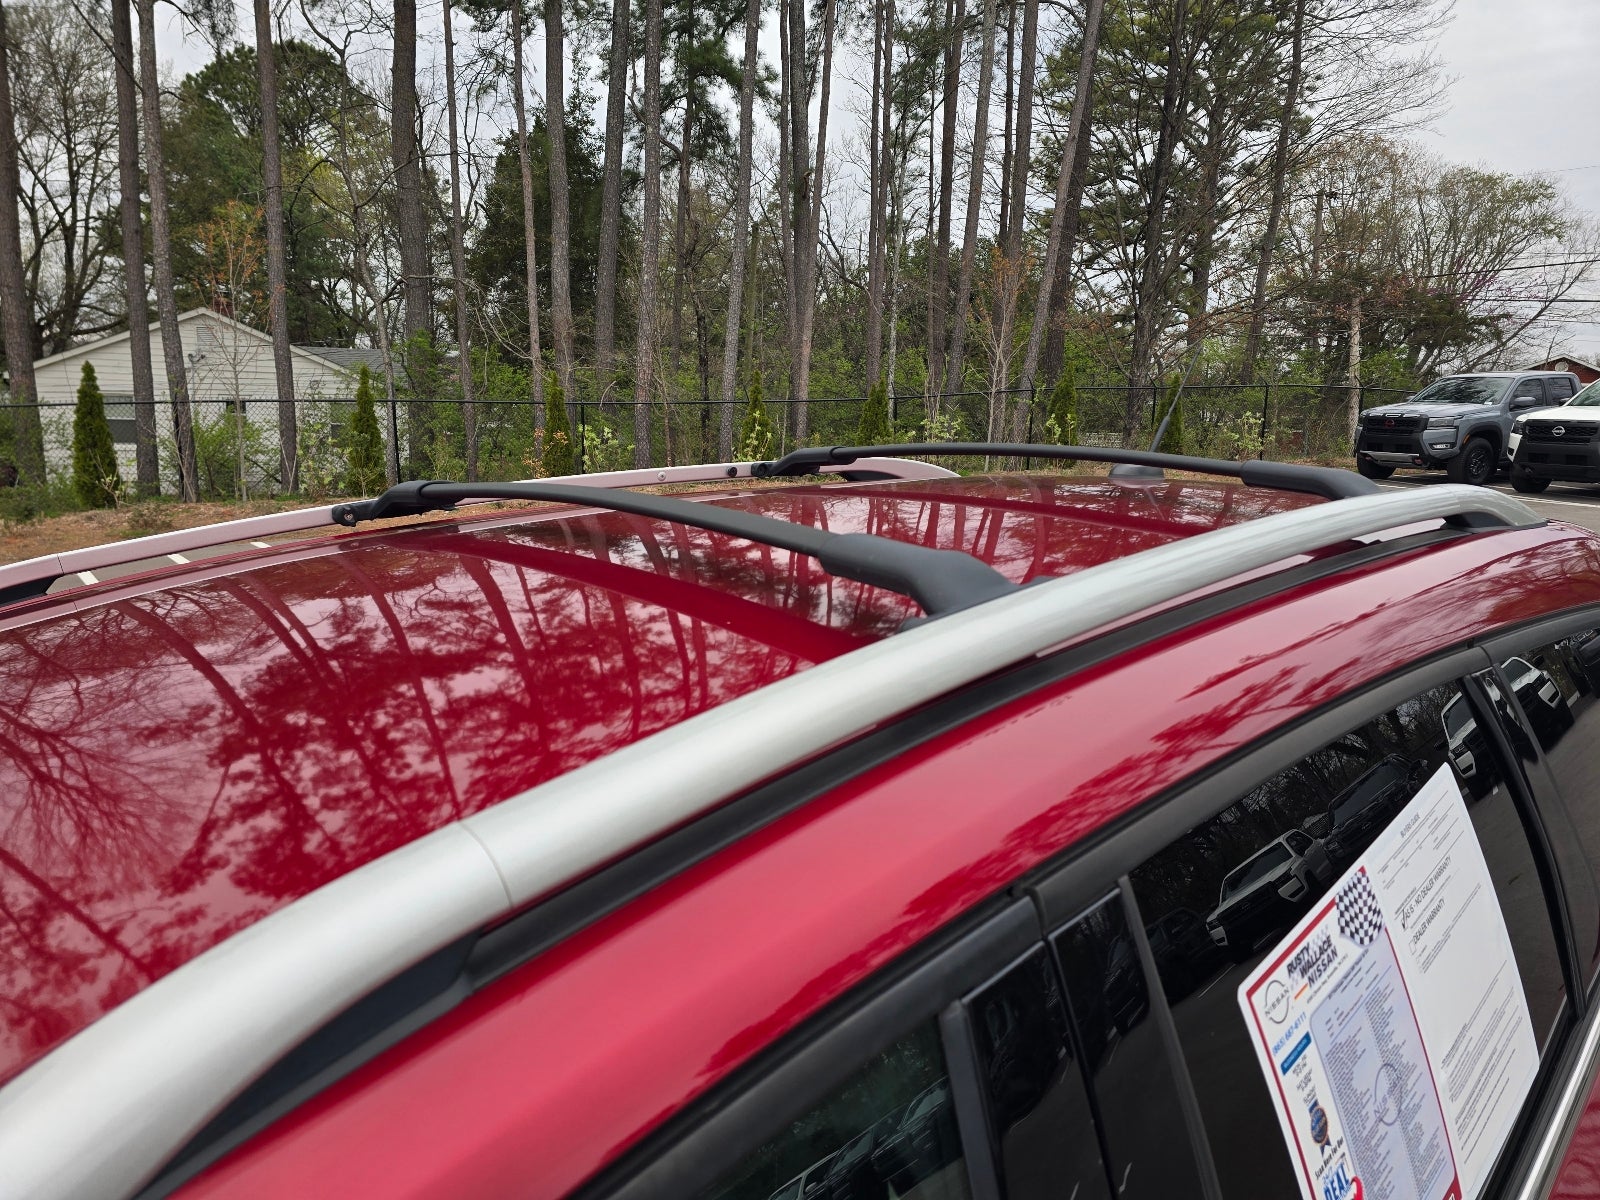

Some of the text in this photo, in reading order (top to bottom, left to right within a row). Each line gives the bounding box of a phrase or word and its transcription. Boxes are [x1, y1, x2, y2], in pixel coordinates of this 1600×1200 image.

[1420, 877, 1435, 900] DEALER
[1433, 855, 1452, 883] WARRANTY
[1412, 921, 1428, 944] DEALER
[1425, 897, 1445, 927] WARRANTY
[1287, 942, 1310, 978] RUSTY
[1299, 935, 1332, 979] WALLACE
[1307, 946, 1338, 988] NISSAN
[1264, 986, 1289, 1017] NISSAN
[1314, 1165, 1325, 1180] Scan
[1323, 1153, 1333, 1168] Here
[1323, 1161, 1350, 1200] DEAL
